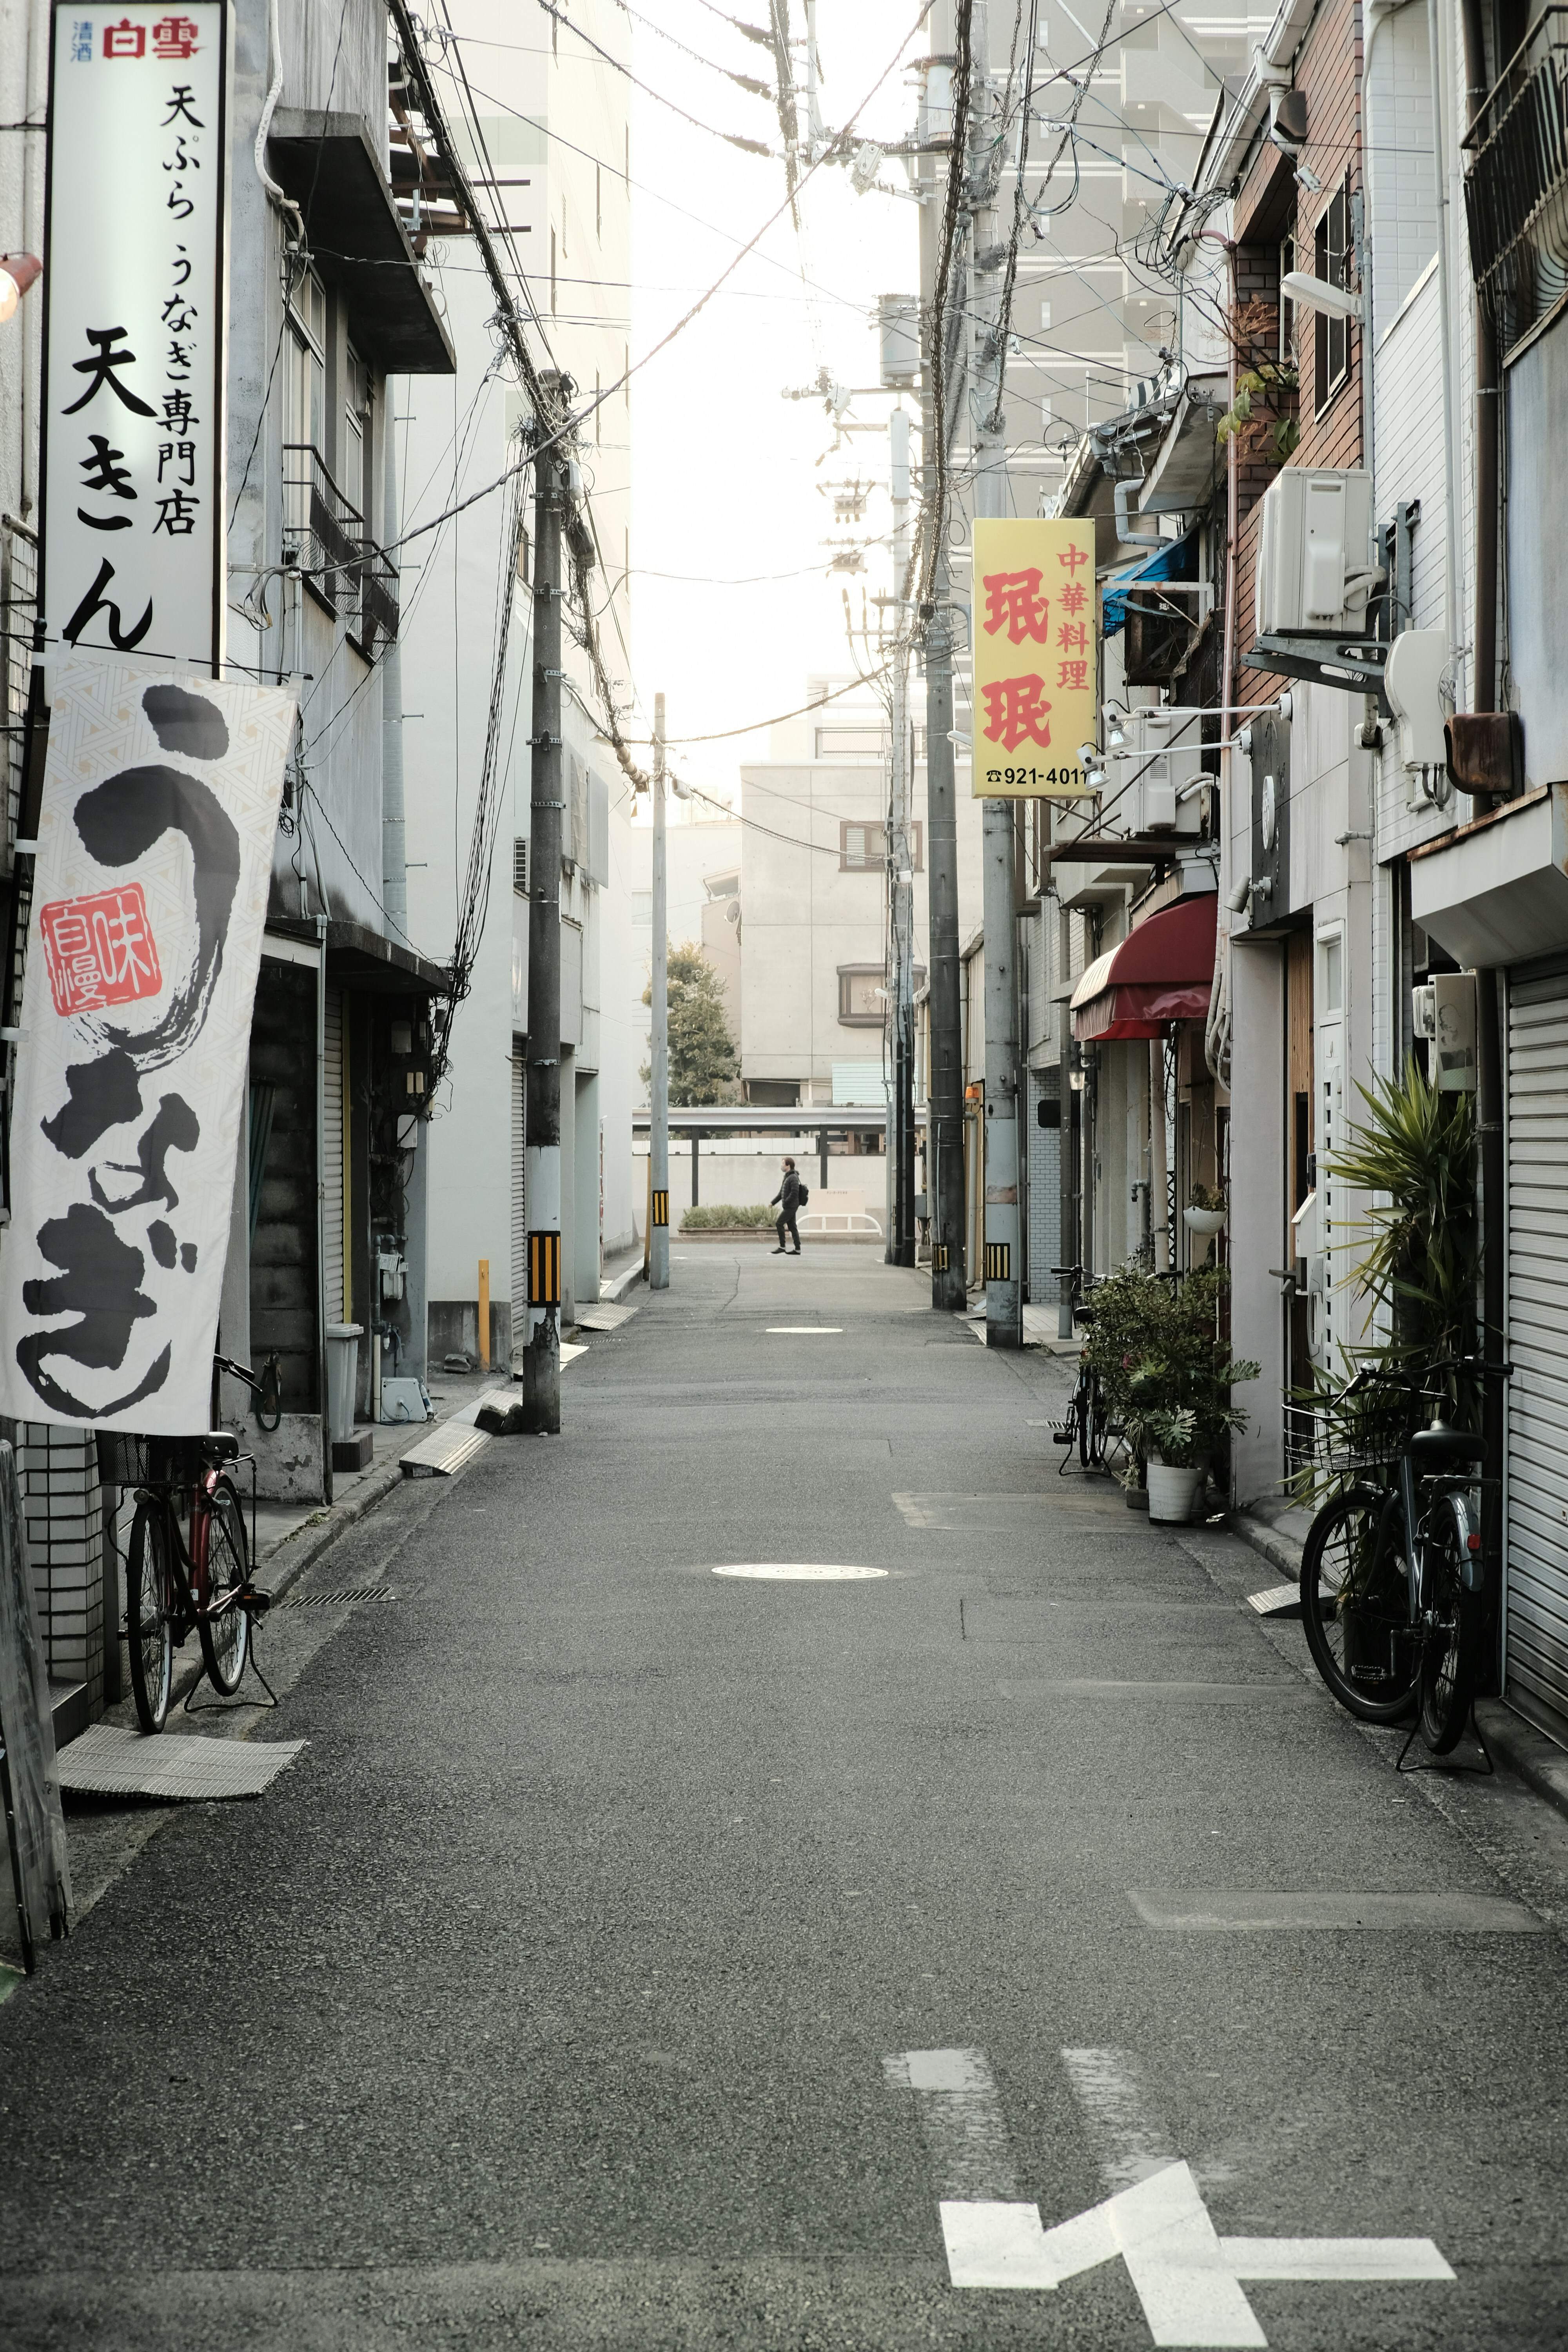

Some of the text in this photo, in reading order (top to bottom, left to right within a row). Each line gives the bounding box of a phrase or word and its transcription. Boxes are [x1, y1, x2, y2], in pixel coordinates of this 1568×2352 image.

[71, 17, 207, 62] 清酒 白雪
[152, 85, 205, 536] 天ぷら うなぎ専門店
[61, 326, 159, 650] 天きん
[981, 567, 1053, 753] 珉珉
[1056, 543, 1090, 690] 中華料理
[1005, 768, 1087, 784] 921-4011
[16, 684, 240, 1419] うなぎ
